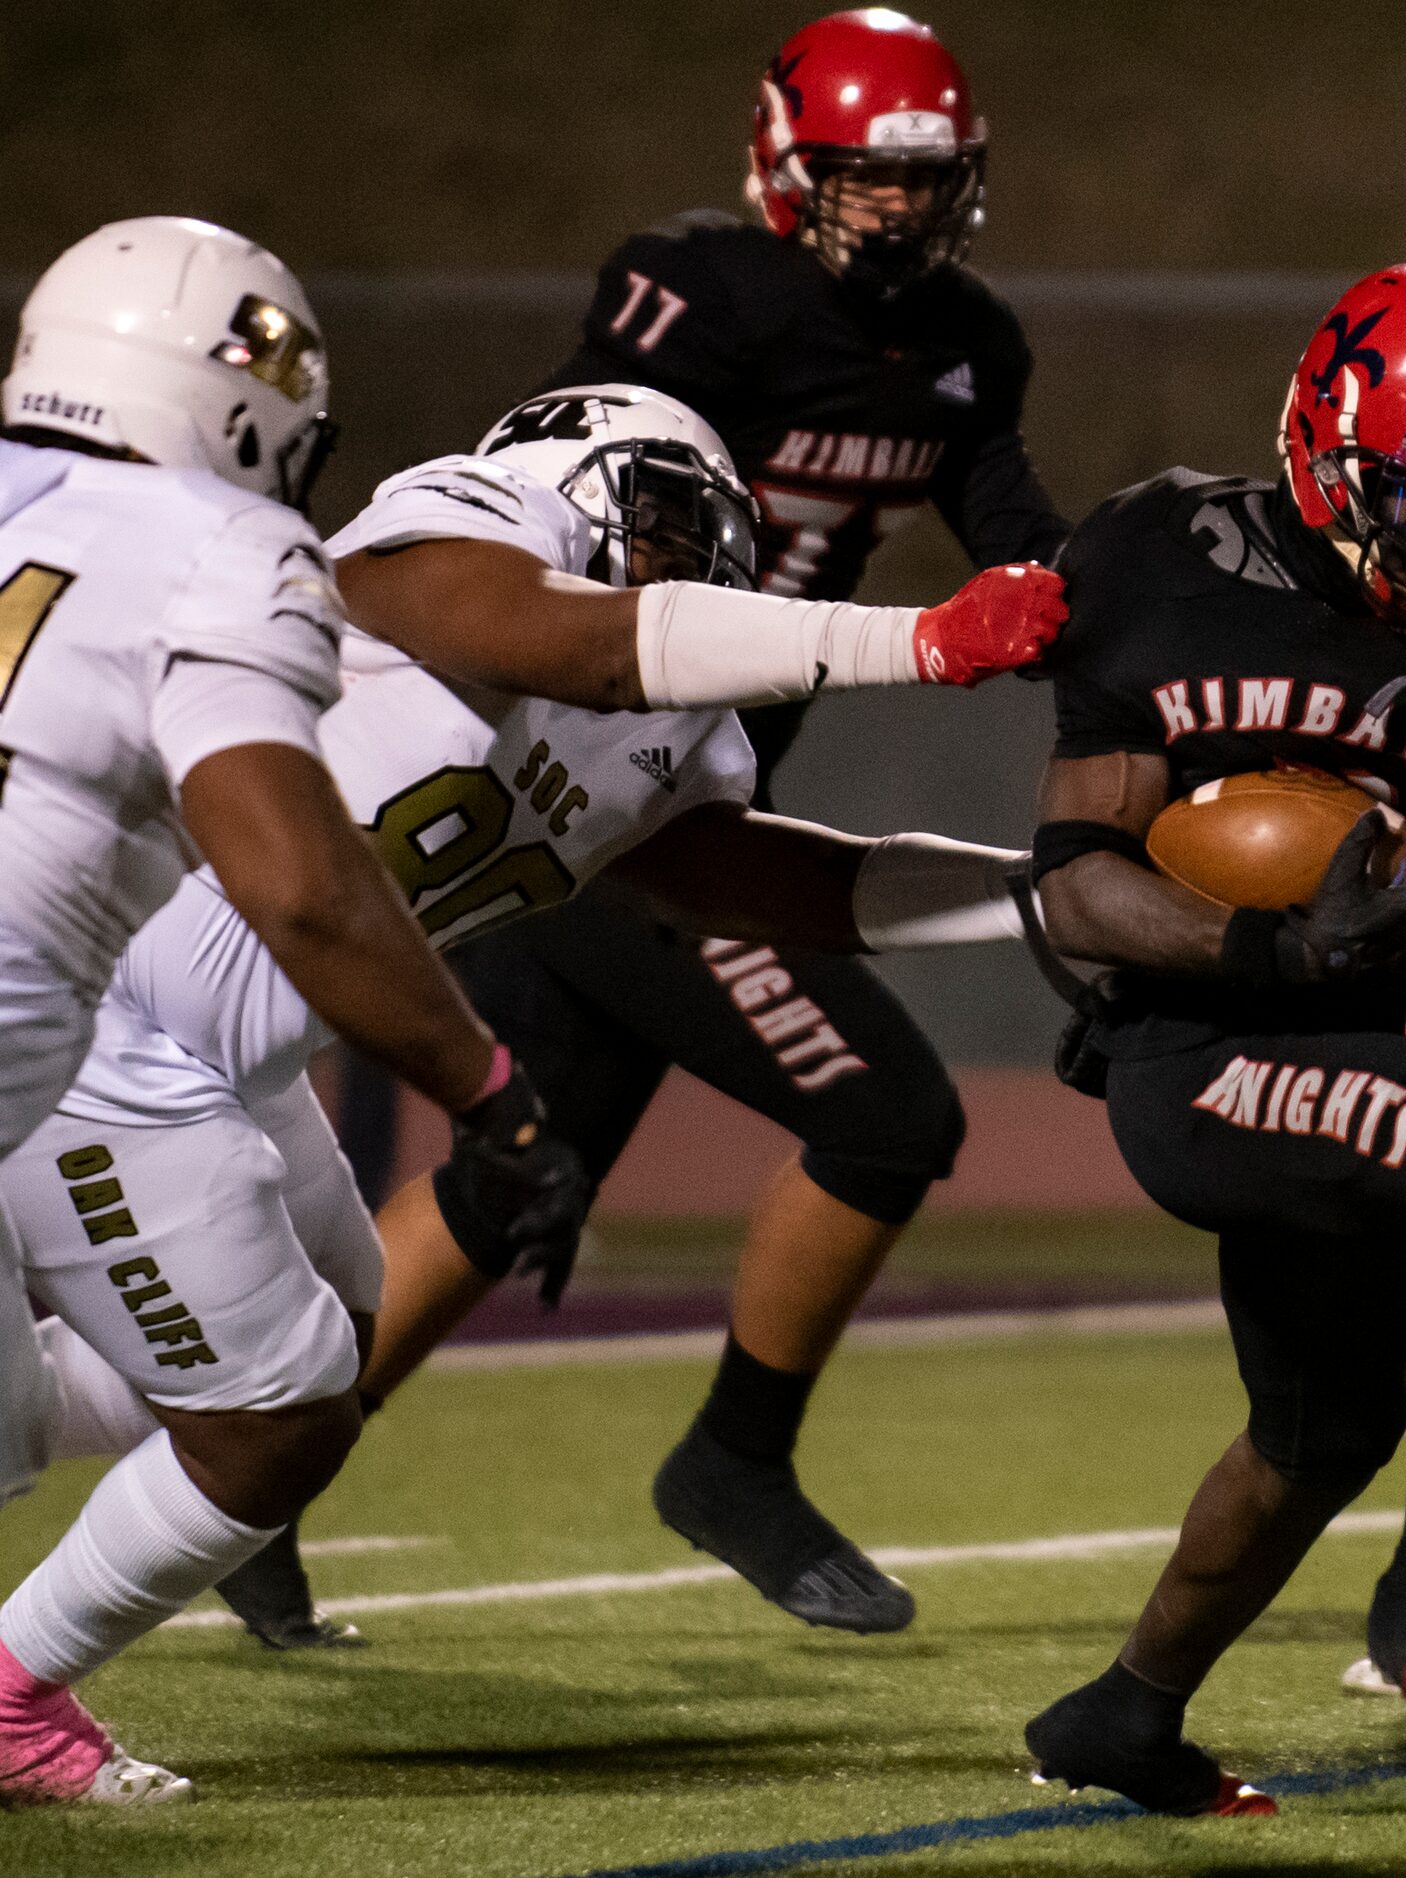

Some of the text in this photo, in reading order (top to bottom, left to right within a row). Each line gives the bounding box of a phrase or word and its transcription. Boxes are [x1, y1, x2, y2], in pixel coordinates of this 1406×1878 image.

[513, 738, 589, 837] SOC
[56, 1144, 219, 1370] OAK CLIFF
